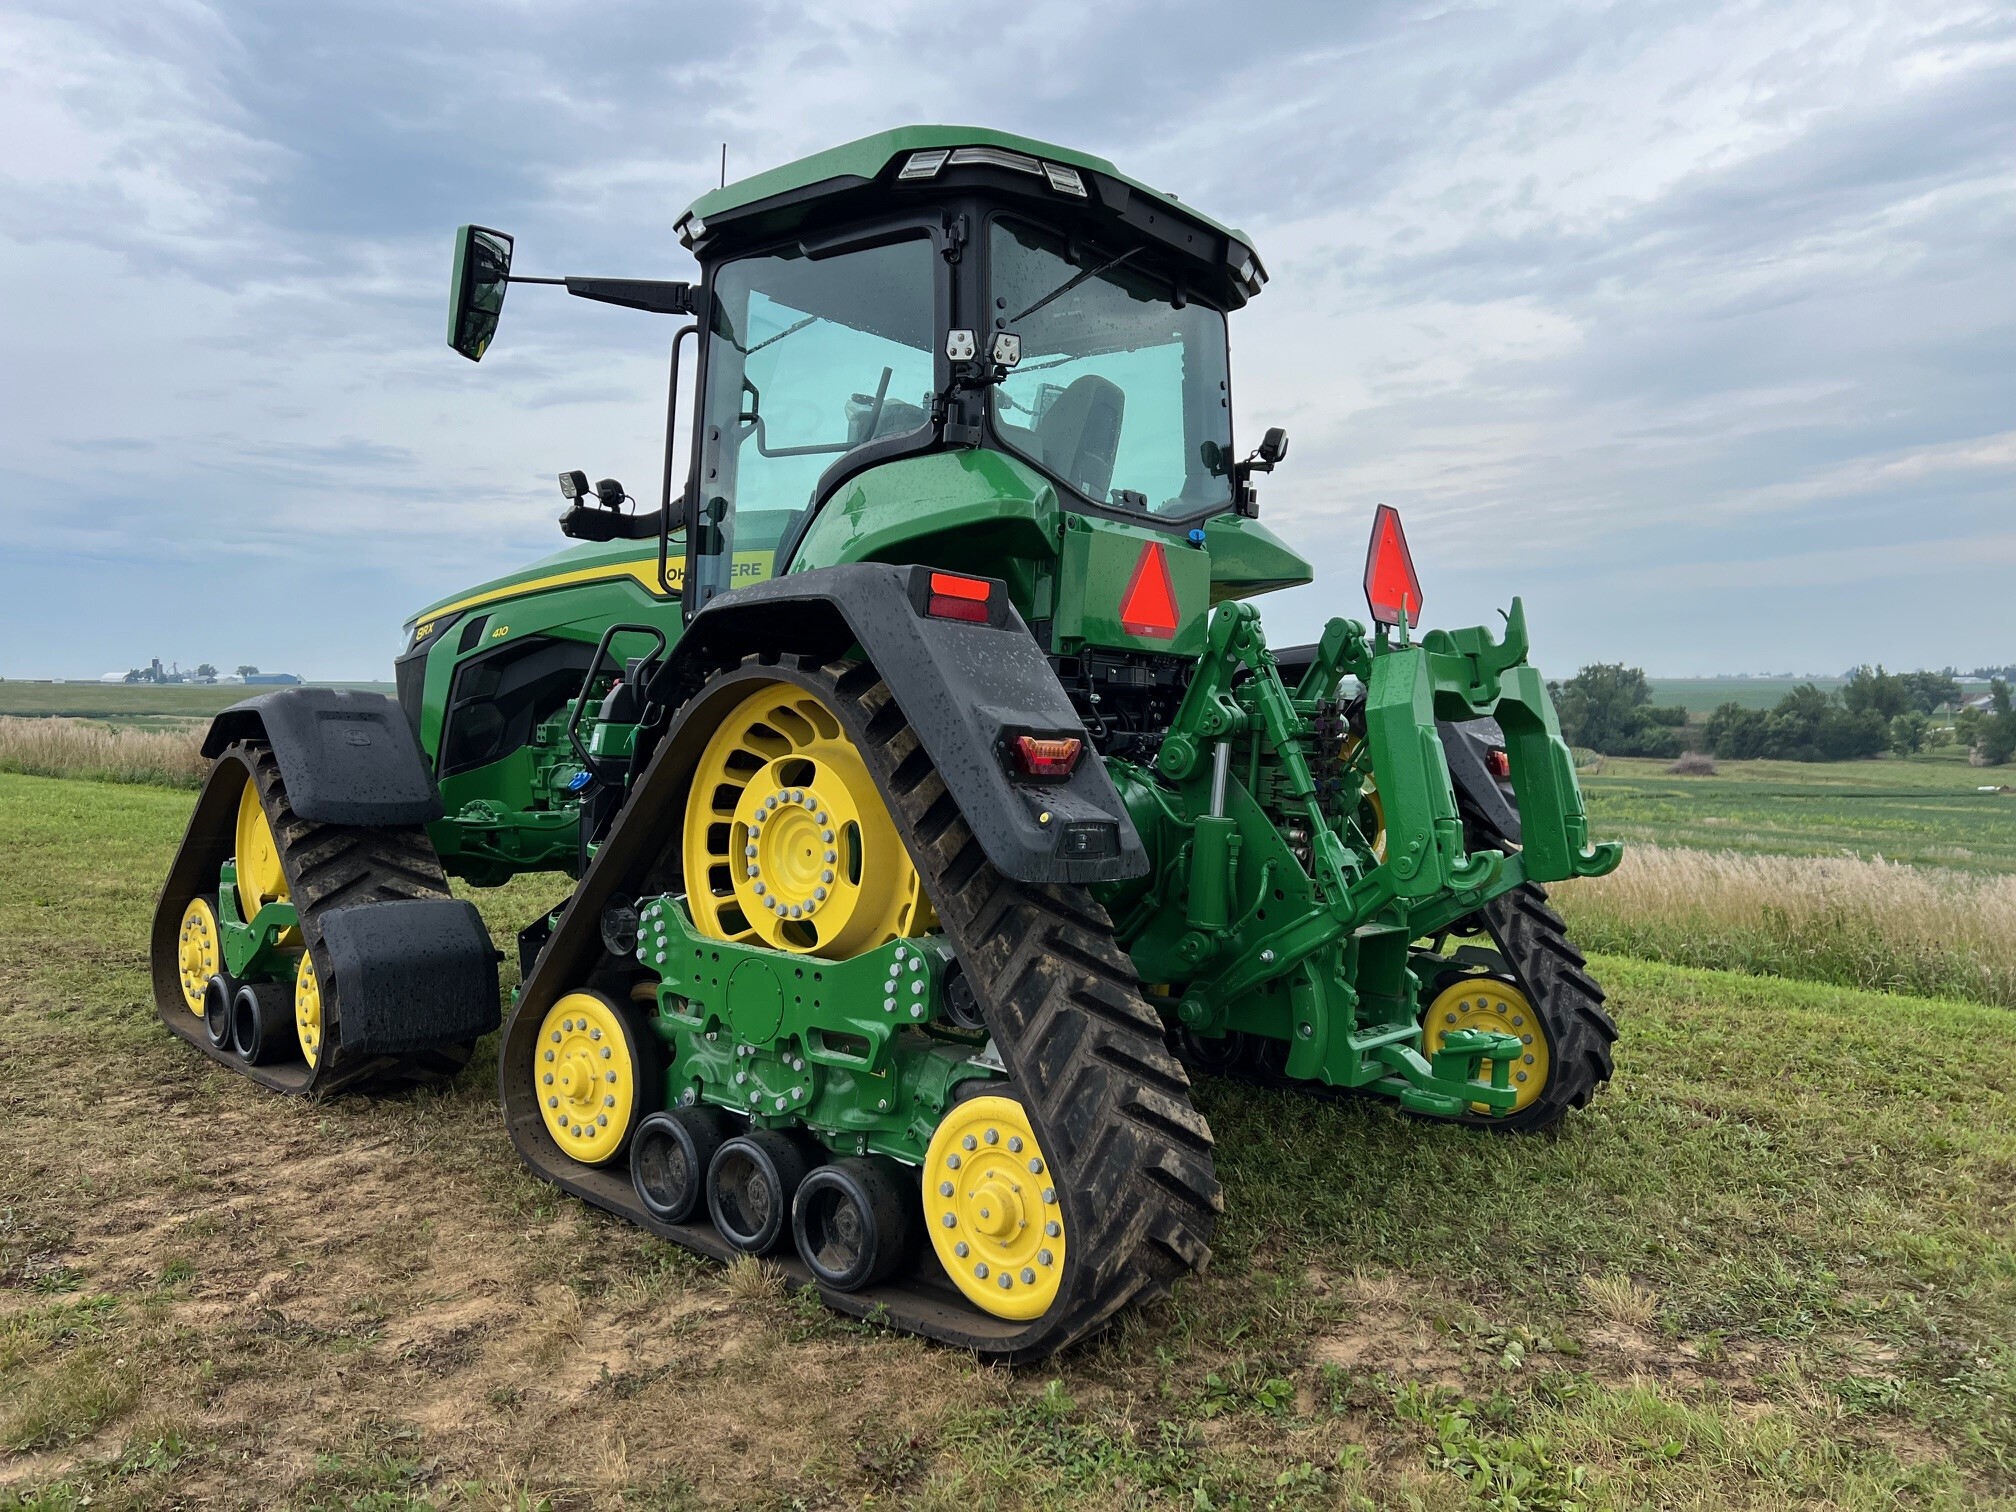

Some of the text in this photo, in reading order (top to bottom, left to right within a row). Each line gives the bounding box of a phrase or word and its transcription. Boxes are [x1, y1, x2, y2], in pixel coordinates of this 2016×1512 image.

[666, 562, 762, 581] OH ERE
[415, 622, 435, 641] 8RX
[491, 625, 509, 639] 410
